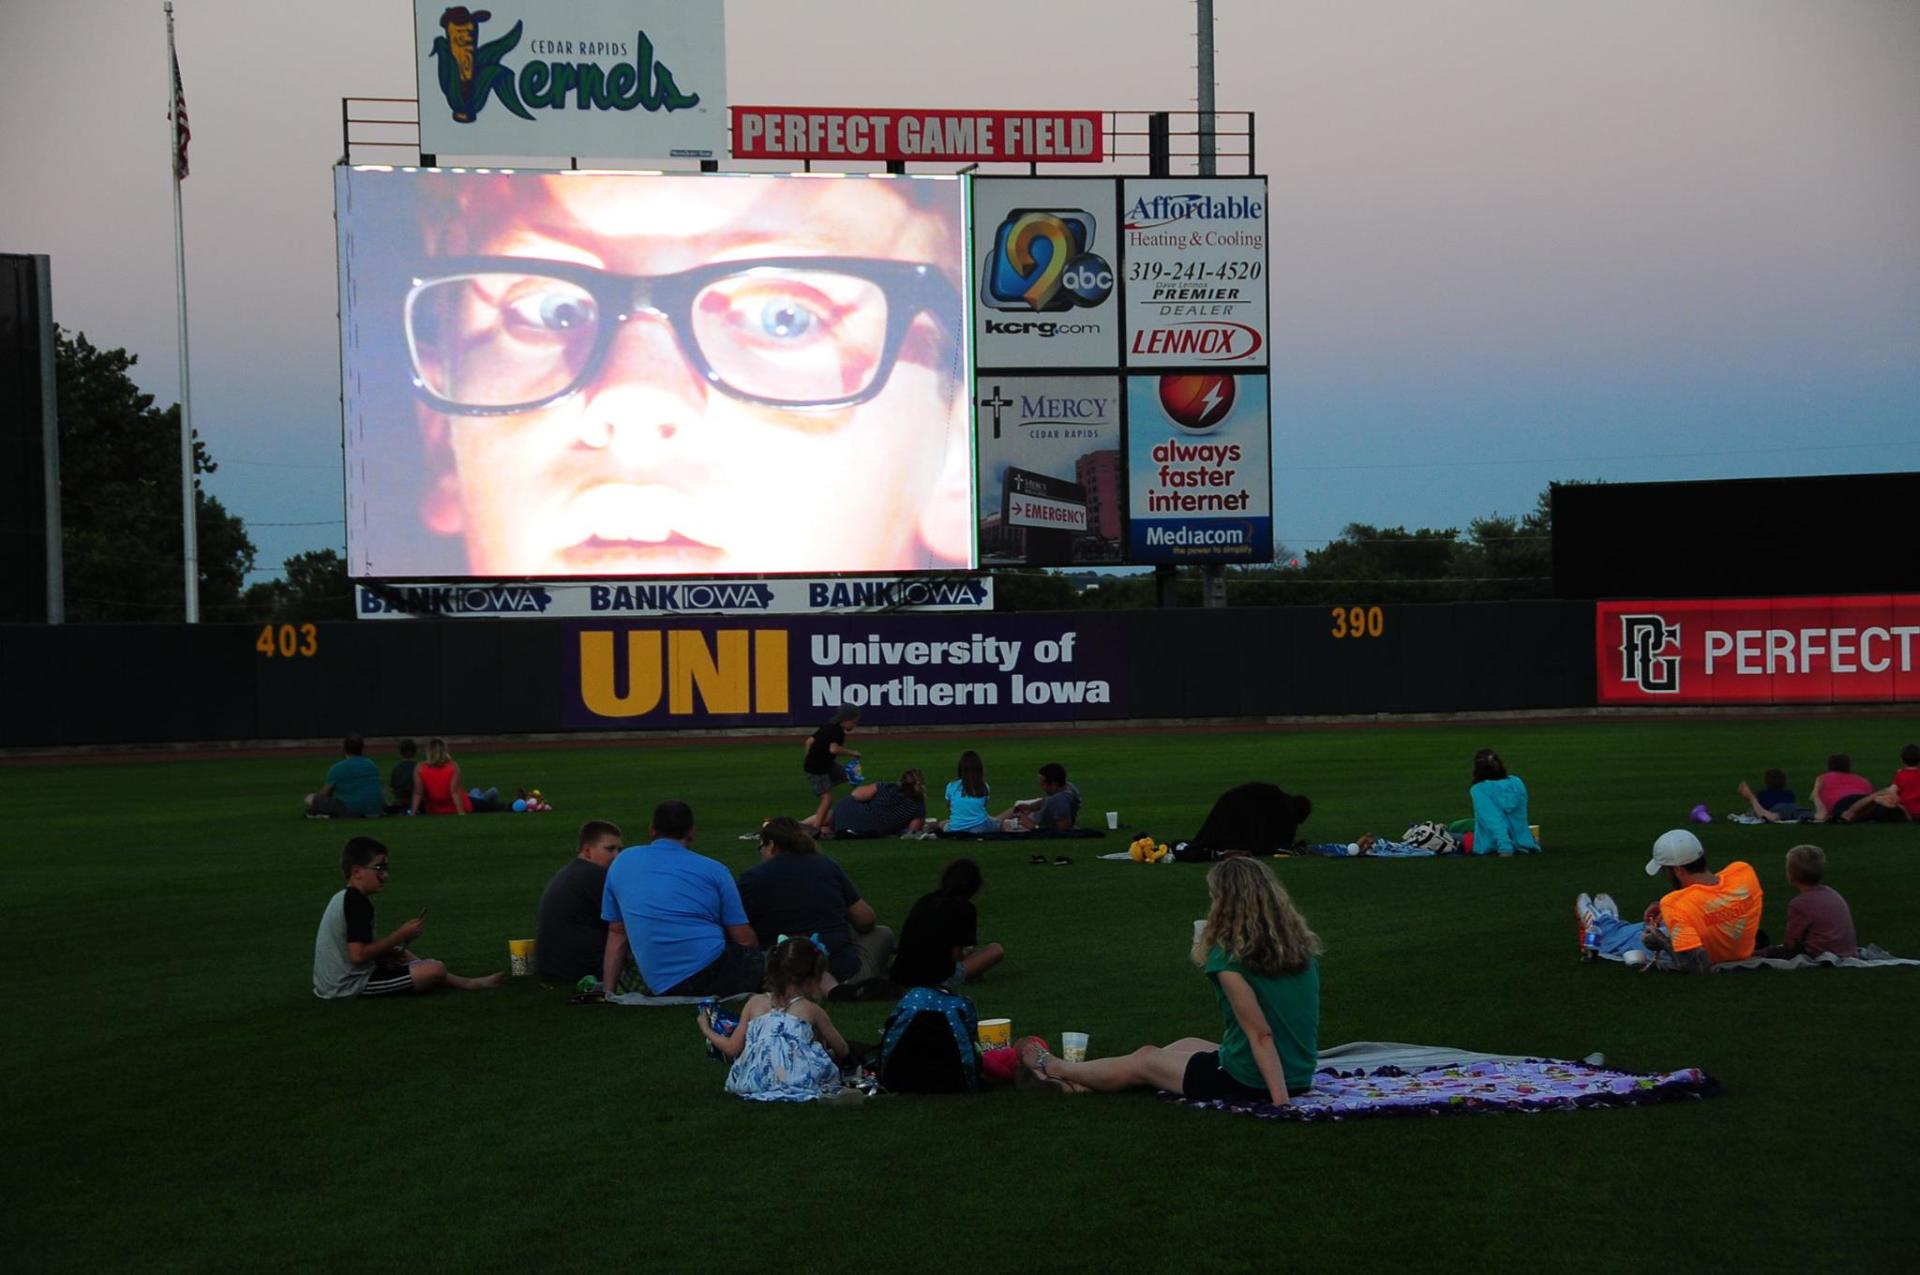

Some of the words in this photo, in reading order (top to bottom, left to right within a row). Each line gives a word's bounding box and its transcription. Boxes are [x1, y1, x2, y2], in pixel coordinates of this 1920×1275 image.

[531, 39, 573, 55] CEDAR
[580, 41, 628, 56] RAPIDS
[429, 10, 700, 123] Kernels
[741, 114, 890, 152] PERFECT
[898, 116, 994, 155] GAME
[1004, 118, 1093, 156] FIELD
[1130, 195, 1262, 220] Affordable
[1130, 231, 1186, 249] Heating
[1189, 231, 1201, 246] &
[1205, 231, 1263, 249] Cooling
[1062, 265, 1112, 290] abc
[1129, 261, 1262, 281] 319-241-4520
[1152, 288, 1240, 300] PREMIER
[1159, 305, 1234, 316] DEALER
[985, 319, 1100, 338] kcrg.com
[1131, 329, 1237, 354] LENNOX
[1020, 395, 1107, 418] MERCY
[1029, 429, 1060, 439] CEDAR
[1064, 429, 1099, 439] RAPIDS
[1152, 440, 1241, 467] always
[1159, 465, 1236, 488] faster
[1025, 503, 1085, 525] EMERGENCY
[1148, 490, 1250, 513] internet
[1146, 526, 1243, 546] Mediacom
[459, 589, 539, 611] IOWA
[590, 585, 680, 611] BANK
[684, 585, 762, 608] IOWA
[809, 582, 897, 607] BANK
[900, 583, 976, 605] IOWA
[1331, 606, 1384, 638] 390
[256, 623, 317, 657] 403
[811, 633, 1022, 671] University
[1033, 632, 1076, 663] of
[1705, 626, 1920, 674] PERFECT
[579, 629, 789, 717] UNI
[811, 676, 1000, 706] Northern
[1010, 675, 1111, 704] Iowa
